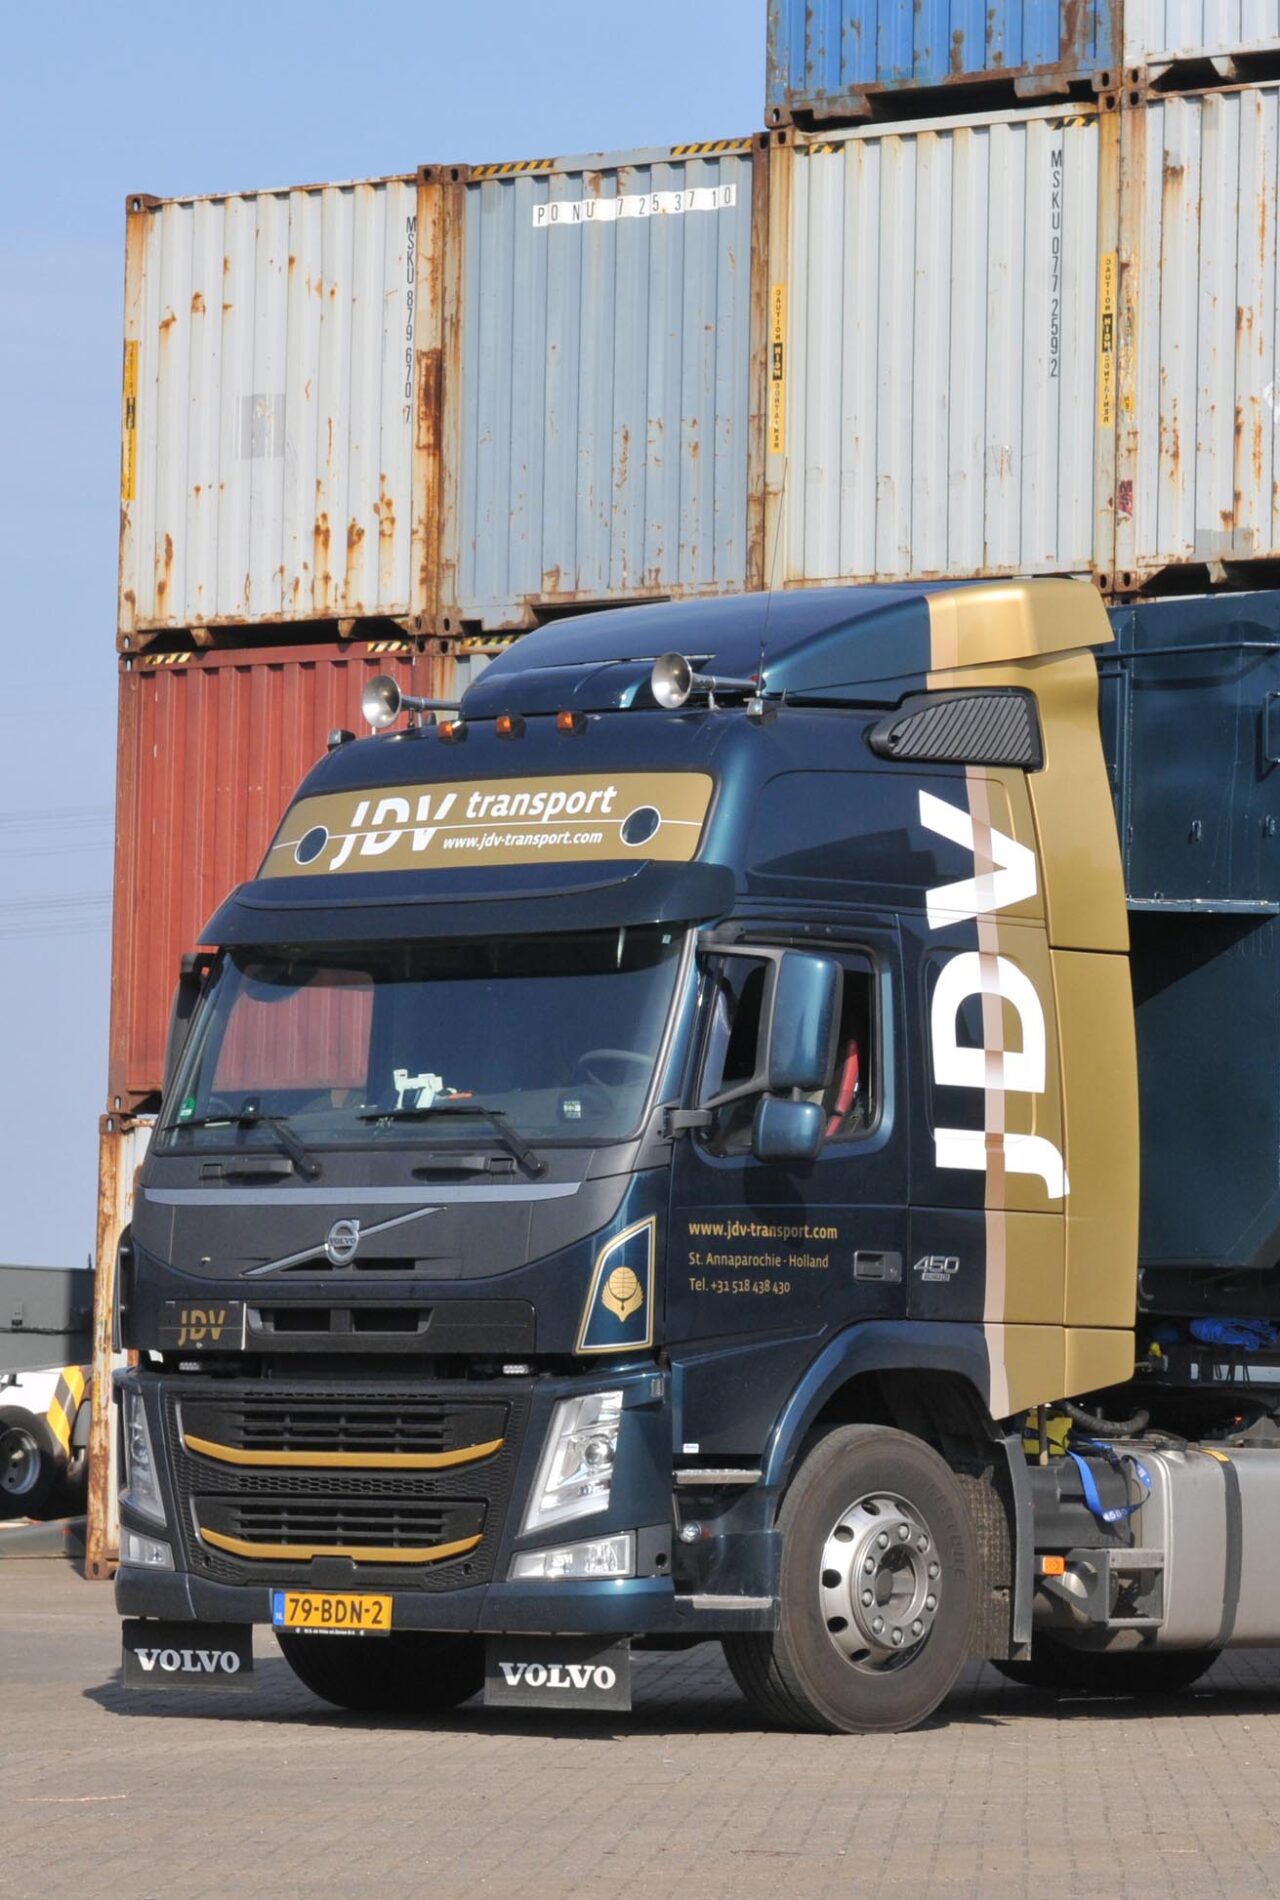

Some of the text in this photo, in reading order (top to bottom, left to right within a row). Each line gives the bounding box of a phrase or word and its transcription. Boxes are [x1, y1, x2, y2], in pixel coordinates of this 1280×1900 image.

[1050, 149, 1063, 230] MSKU
[405, 216, 417, 285] MSKU
[1050, 236, 1060, 293] 077
[405, 290, 414, 341] 879
[404, 347, 413, 399] 670
[328, 785, 618, 872] JDV transport
[442, 828, 603, 851] www.jdv-transport.com
[918, 789, 1071, 1200] JDV
[328, 1236, 357, 1246] VOLVO
[688, 1220, 838, 1241] www.jdv-transport.com
[688, 1251, 703, 1266] St.
[706, 1252, 781, 1269] Annaparochie
[789, 1253, 829, 1269] Holland
[913, 1255, 960, 1275] 450
[688, 1276, 791, 1295] Tel. +31 518 438 430
[177, 1309, 227, 1347] JDV
[289, 1597, 383, 1625] 79-BDN-2
[134, 1648, 241, 1675] VOLVO
[498, 1661, 617, 1690] VOLVO
